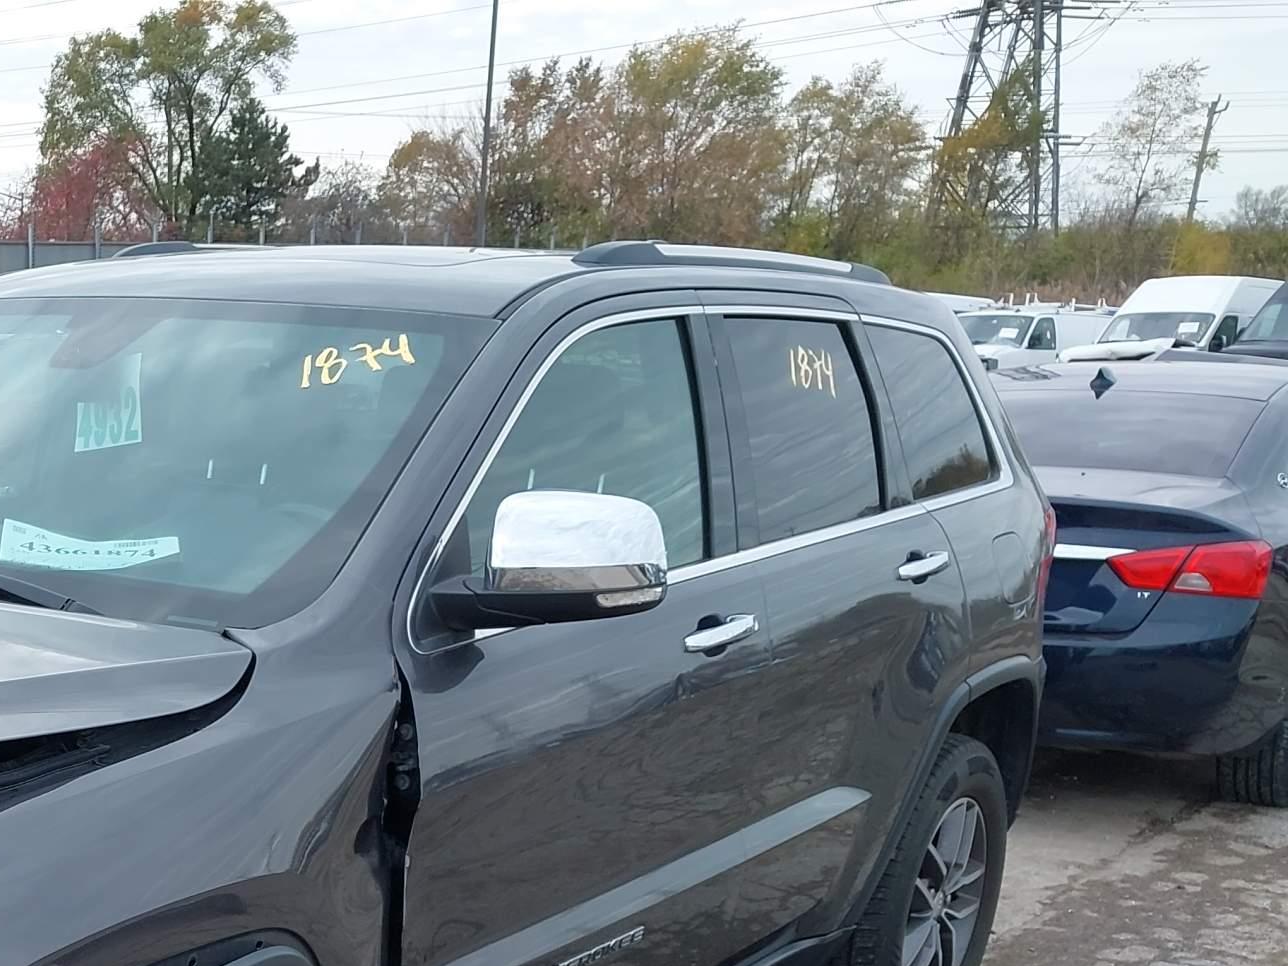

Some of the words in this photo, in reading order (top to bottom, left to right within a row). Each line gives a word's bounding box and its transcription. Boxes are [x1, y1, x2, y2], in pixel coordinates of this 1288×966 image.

[300, 333, 416, 389] 1874
[790, 344, 837, 400] 1874
[19, 540, 156, 558] 43661874
